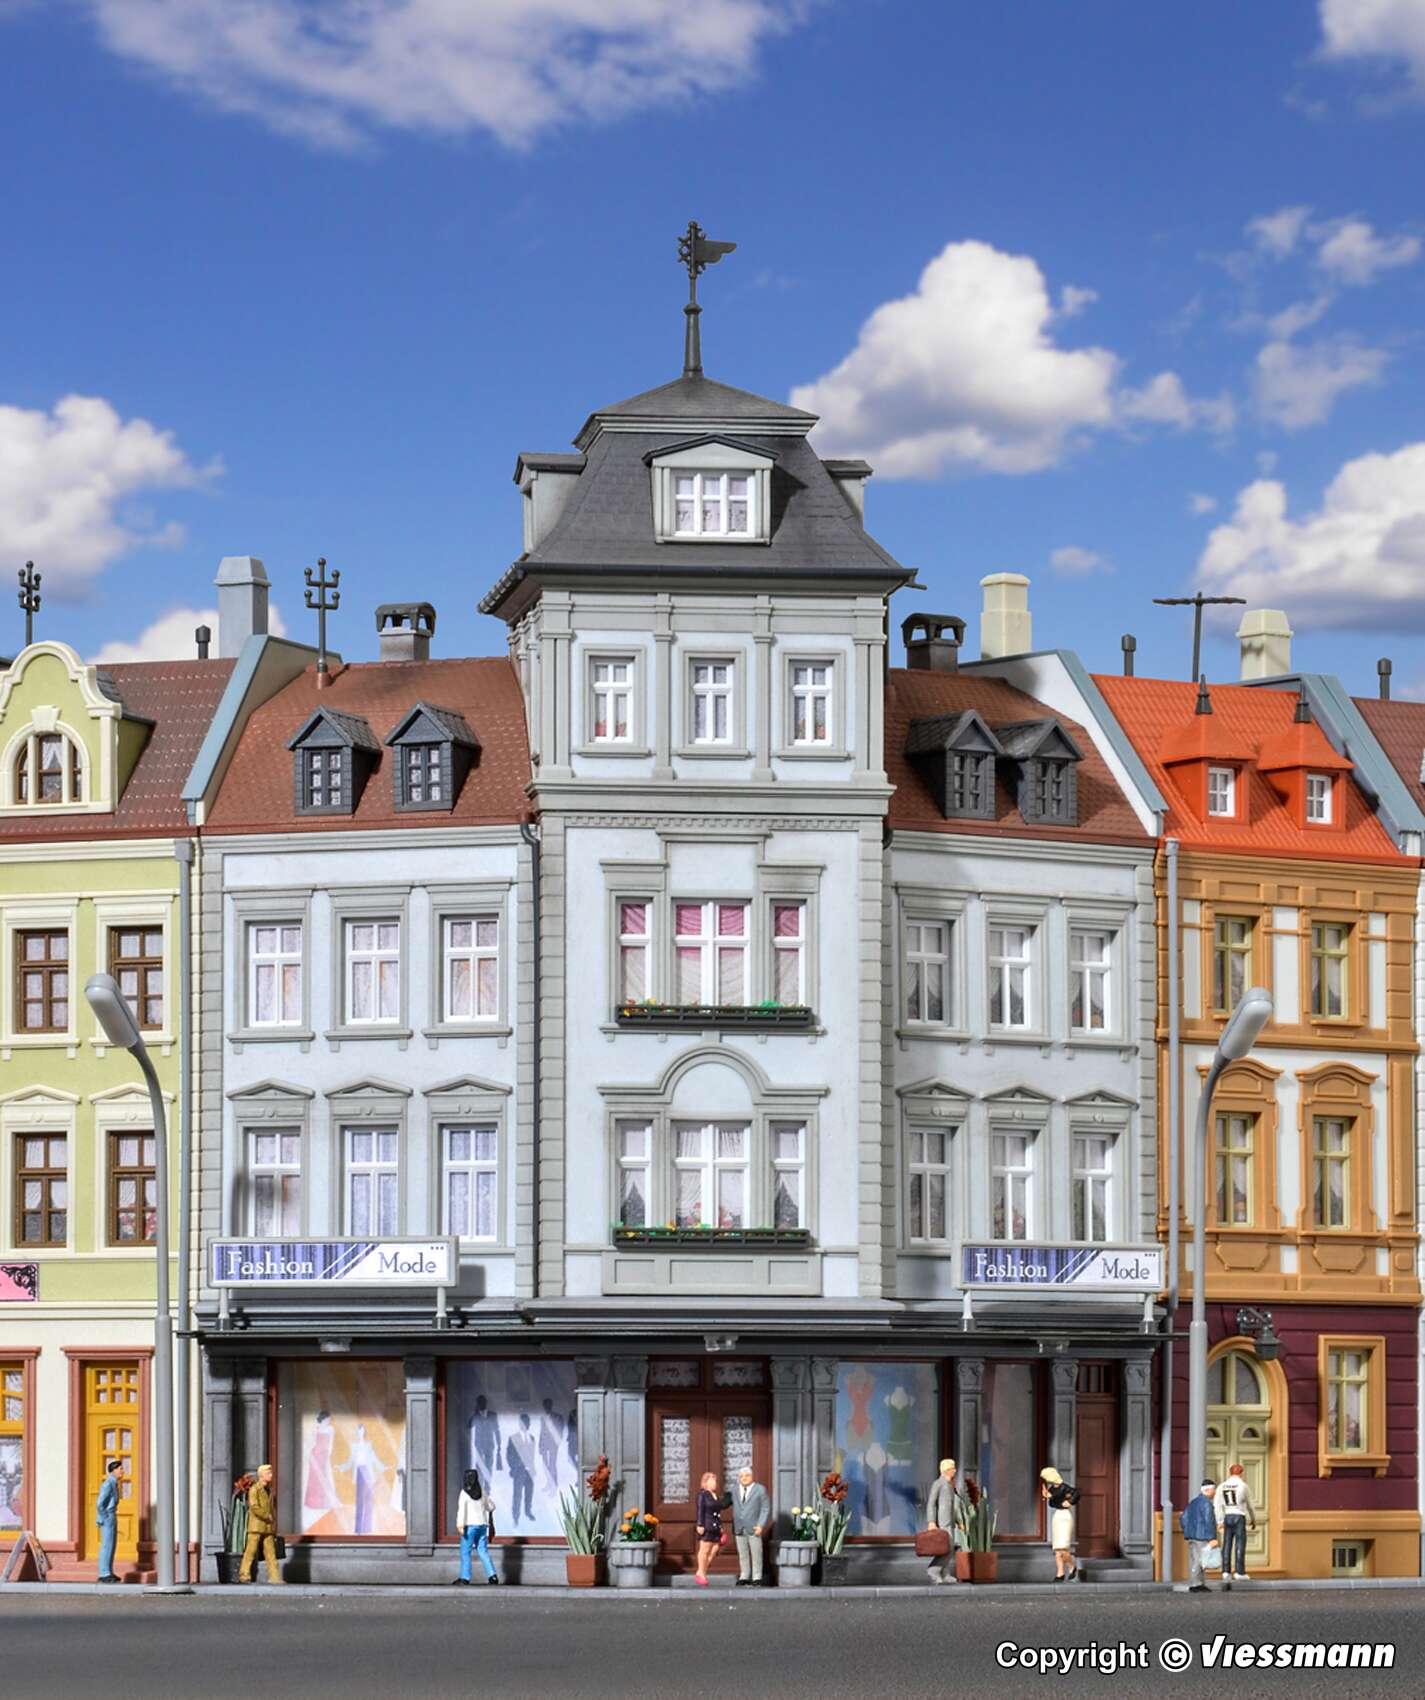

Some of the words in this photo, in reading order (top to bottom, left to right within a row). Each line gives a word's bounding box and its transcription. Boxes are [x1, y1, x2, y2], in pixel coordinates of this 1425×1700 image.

[227, 1251, 313, 1275] Fashion
[378, 1252, 437, 1274] Mode
[975, 1253, 1047, 1278] Fashion
[1101, 1257, 1150, 1280] Mode
